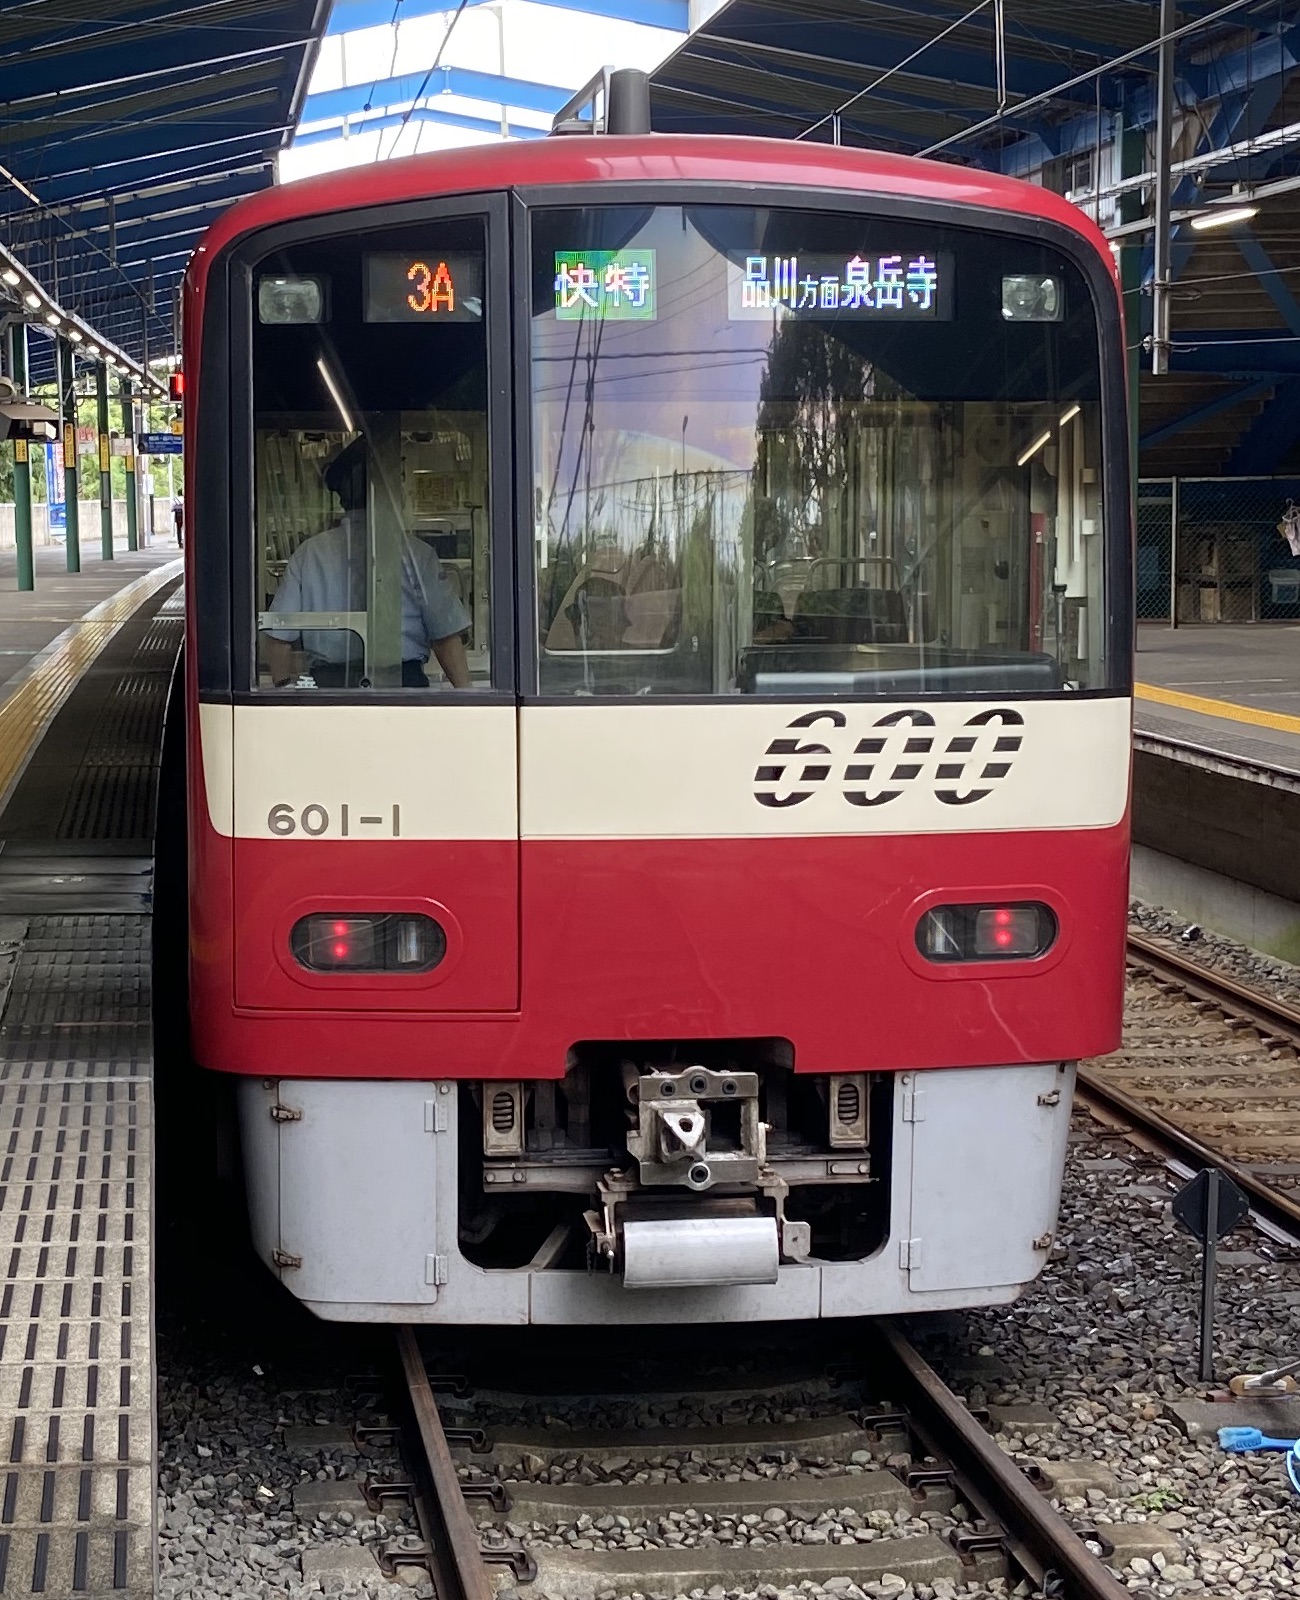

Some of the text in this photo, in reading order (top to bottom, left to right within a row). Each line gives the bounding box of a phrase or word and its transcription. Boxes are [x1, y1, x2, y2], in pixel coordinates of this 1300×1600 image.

[407, 261, 455, 312] 3A
[554, 262, 650, 307] 快特
[741, 255, 937, 309] 品川方面泉岳寺
[753, 708, 1025, 808] 600
[267, 803, 400, 838] 601-1
